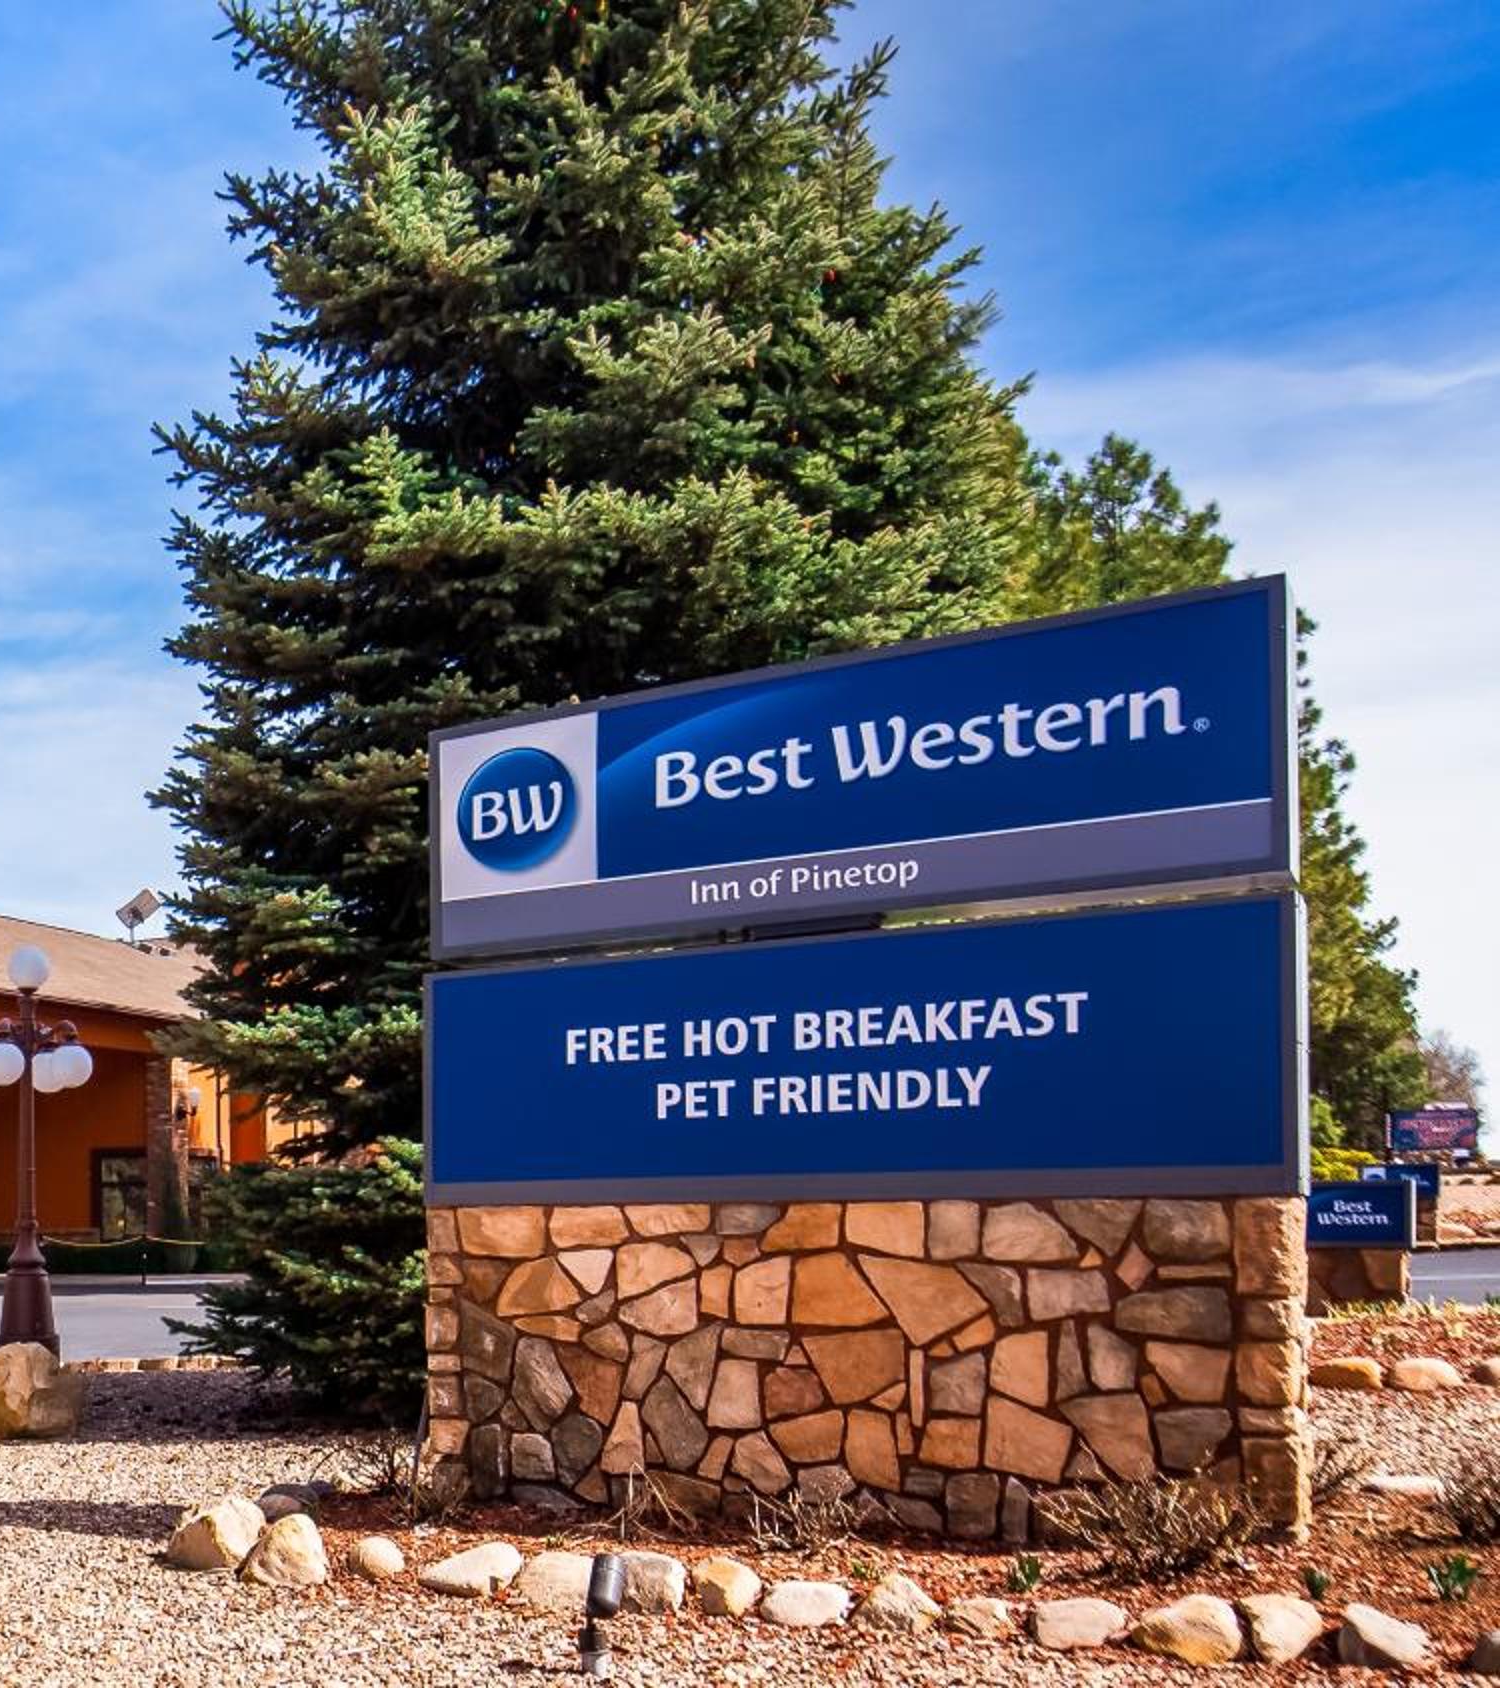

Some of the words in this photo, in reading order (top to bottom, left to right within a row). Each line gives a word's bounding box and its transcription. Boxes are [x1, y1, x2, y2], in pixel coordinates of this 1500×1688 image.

[655, 737, 815, 808] Best
[831, 686, 1187, 782] Western
[471, 780, 563, 841] BW
[690, 879, 742, 906] Inn
[749, 868, 784, 898] of
[790, 859, 920, 893] Pinetop
[566, 1023, 668, 1065] FREE
[683, 1015, 778, 1057] HOT
[794, 992, 1089, 1051] BREAKFAST
[657, 1079, 737, 1120] PET
[753, 1065, 992, 1115] FRIENDLY
[1316, 1212, 1389, 1225] Western
[1332, 1199, 1372, 1213] Best
